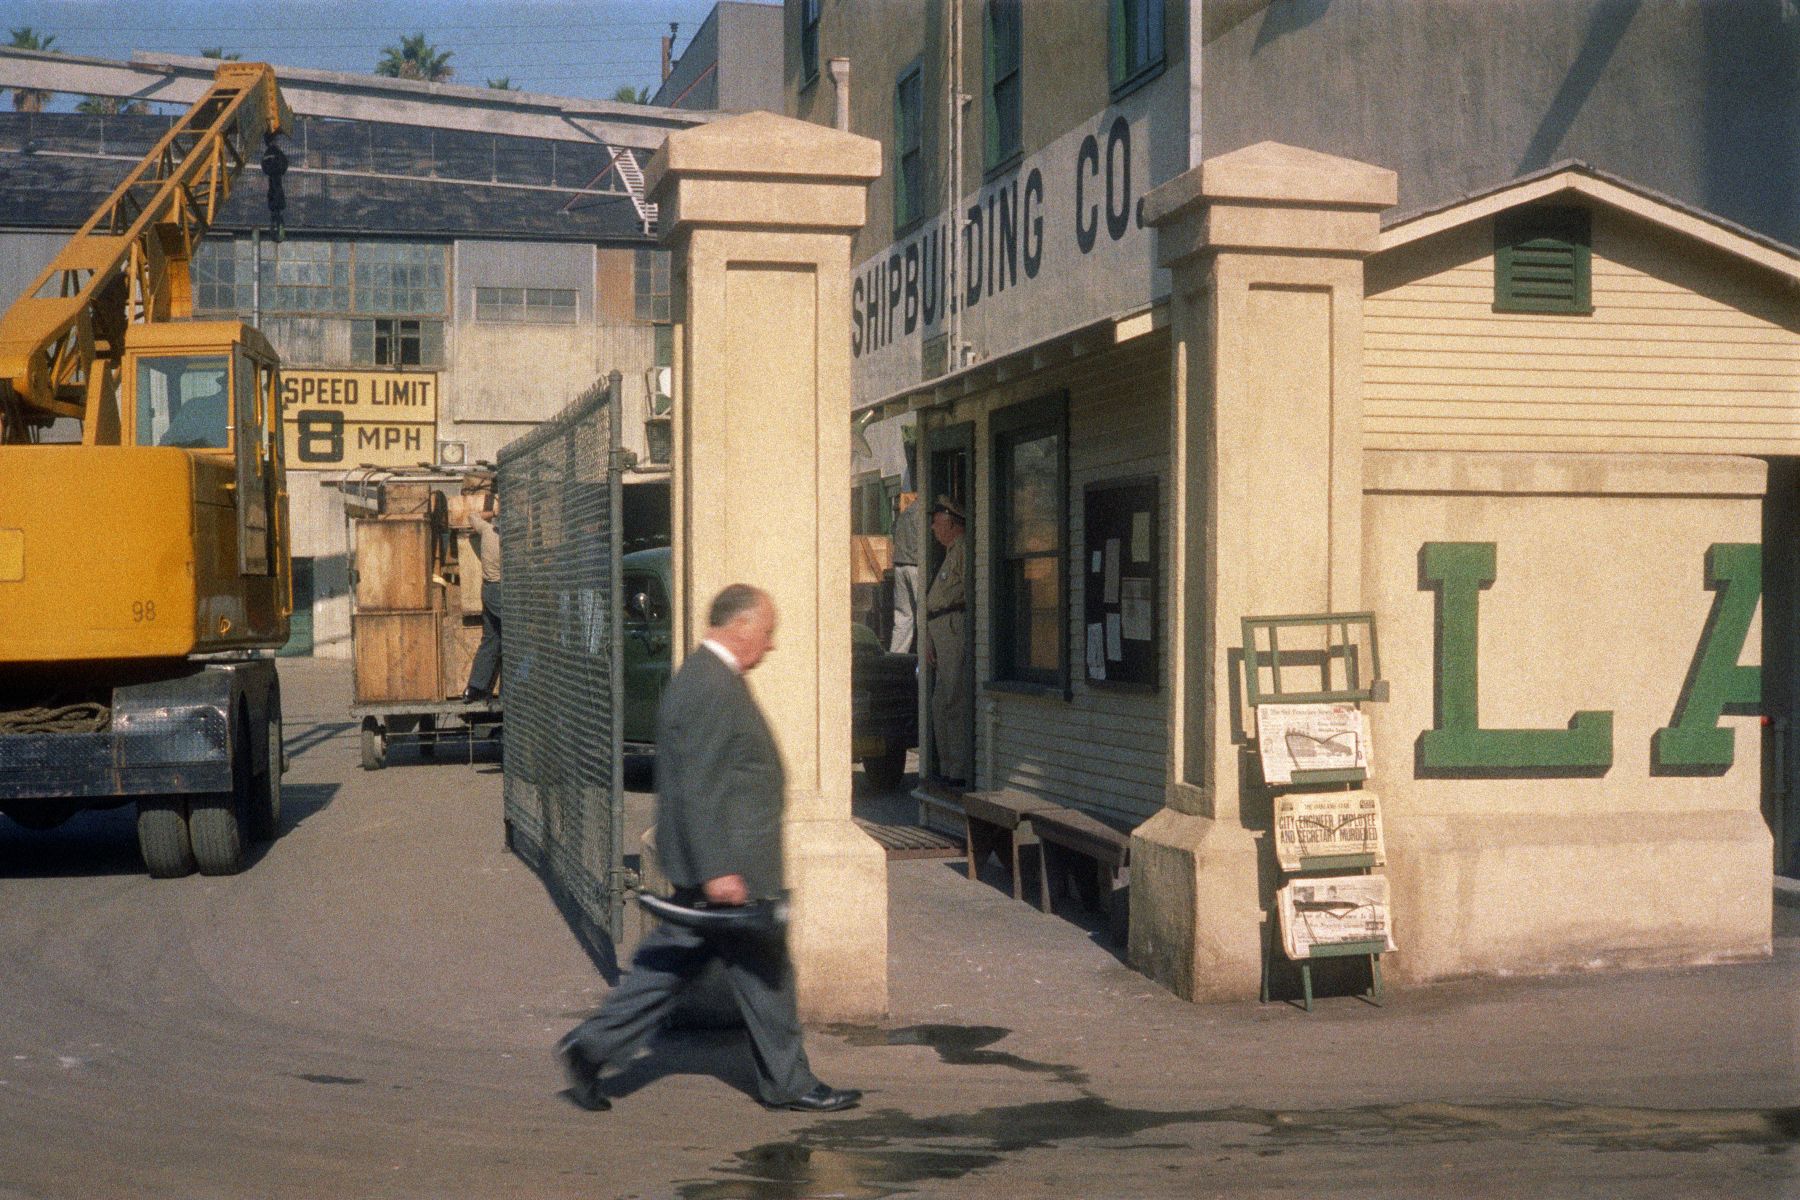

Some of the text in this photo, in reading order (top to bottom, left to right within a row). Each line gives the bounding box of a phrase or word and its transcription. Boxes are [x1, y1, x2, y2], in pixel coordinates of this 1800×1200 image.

[284, 377, 430, 406] SPEED LIMIT
[298, 410, 420, 463] 8 MPH
[132, 600, 156, 622] 98
[1279, 815, 1294, 829] CITY
[1281, 830, 1295, 844] AND
